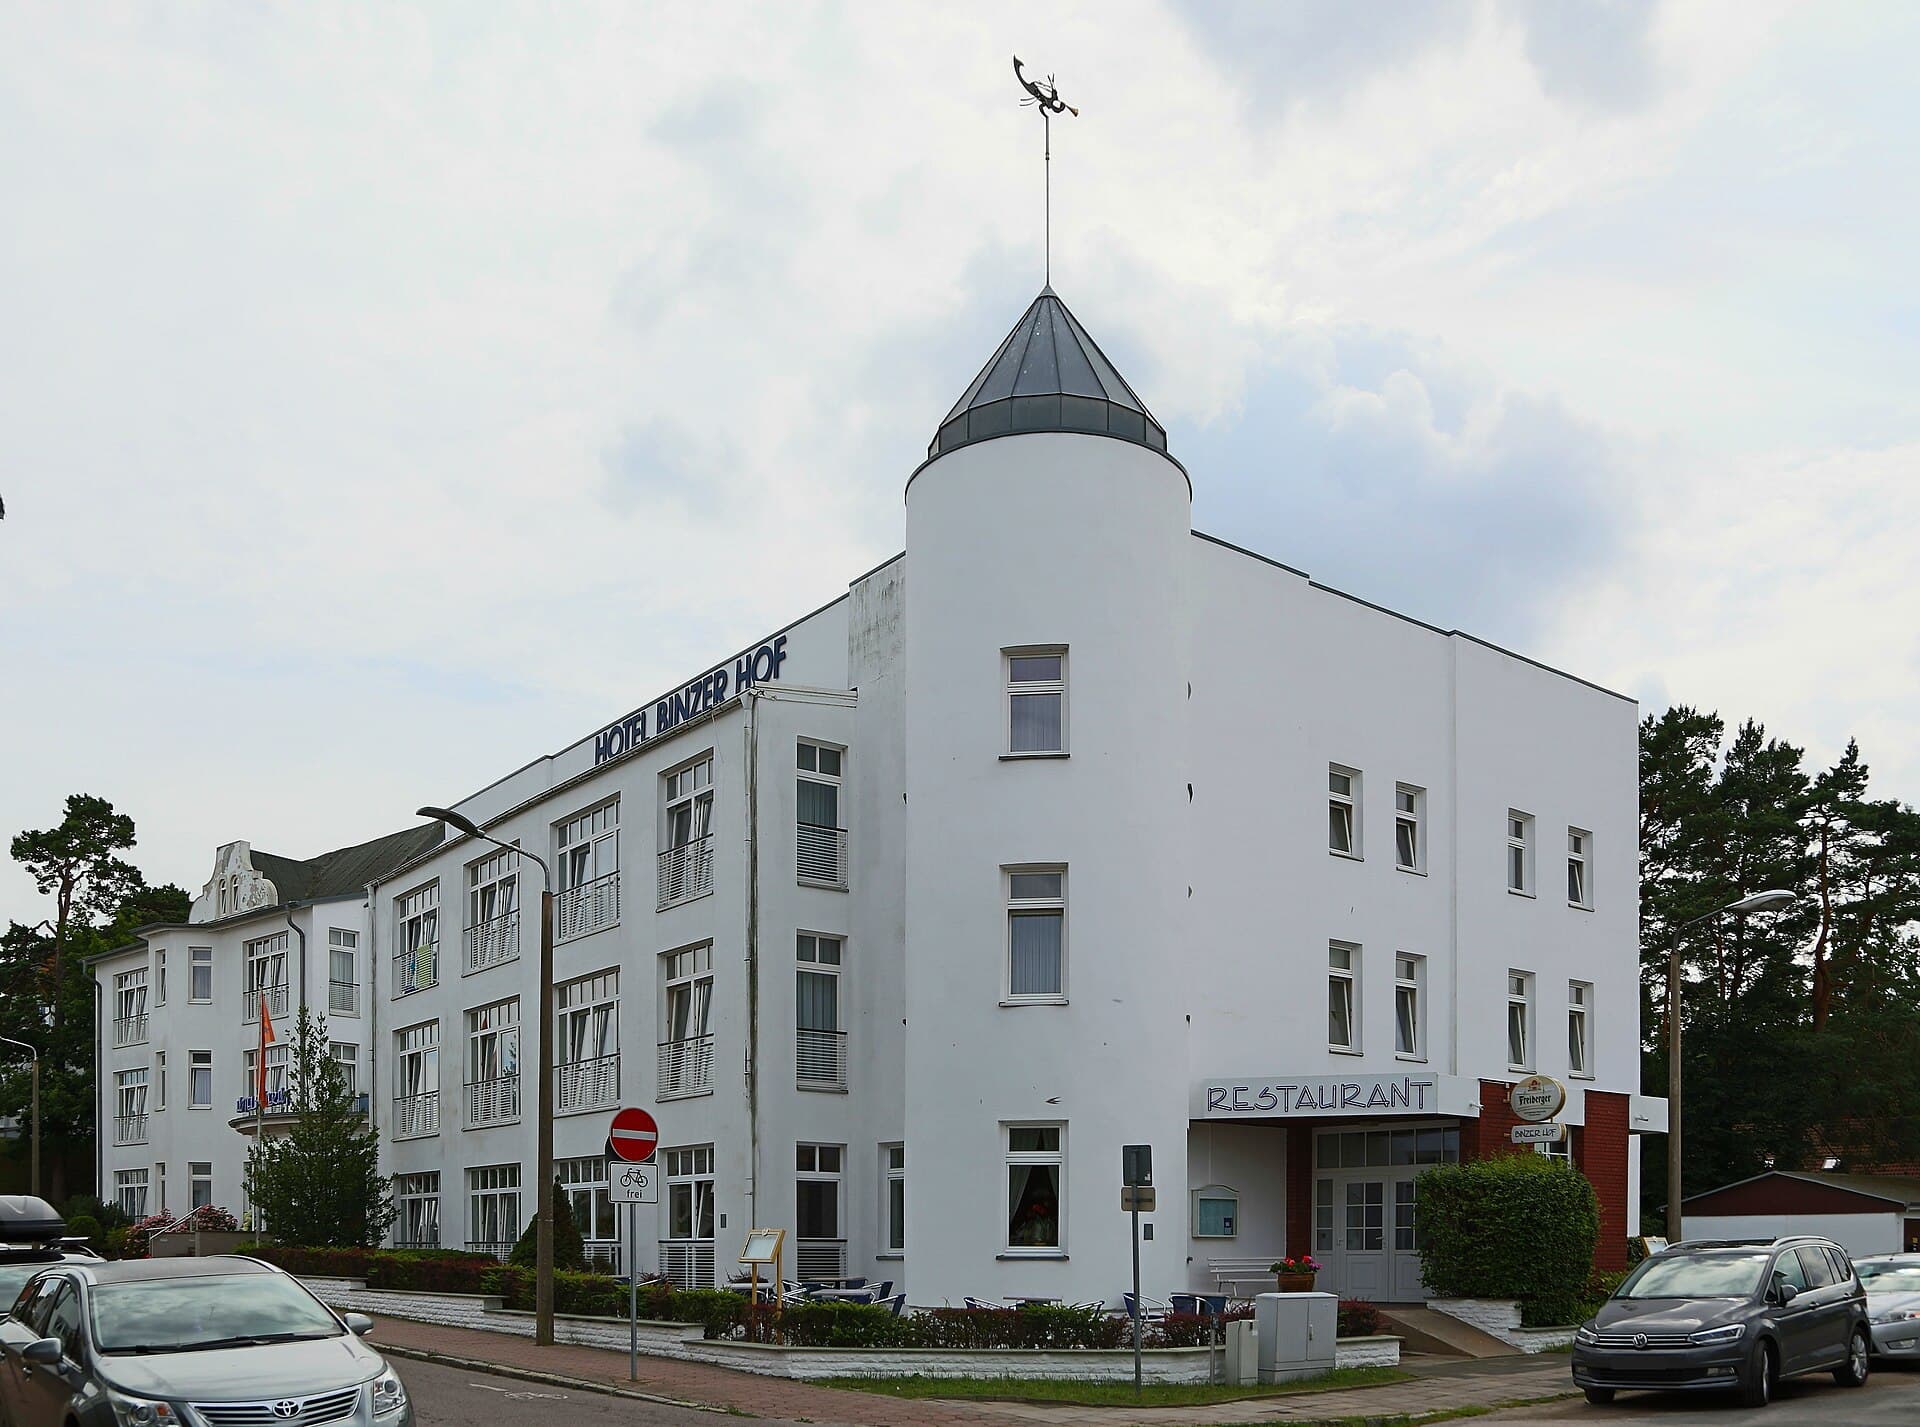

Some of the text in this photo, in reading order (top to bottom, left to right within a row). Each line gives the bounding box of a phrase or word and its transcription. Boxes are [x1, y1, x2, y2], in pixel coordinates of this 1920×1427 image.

[594, 635, 787, 765] HOTEL BINZER HOF
[1207, 1077, 1433, 1112] RESTAURANT
[1519, 1095, 1552, 1106] Freiberger
[1514, 1127, 1557, 1138] BINZER HOF
[626, 1189, 643, 1199] frei
